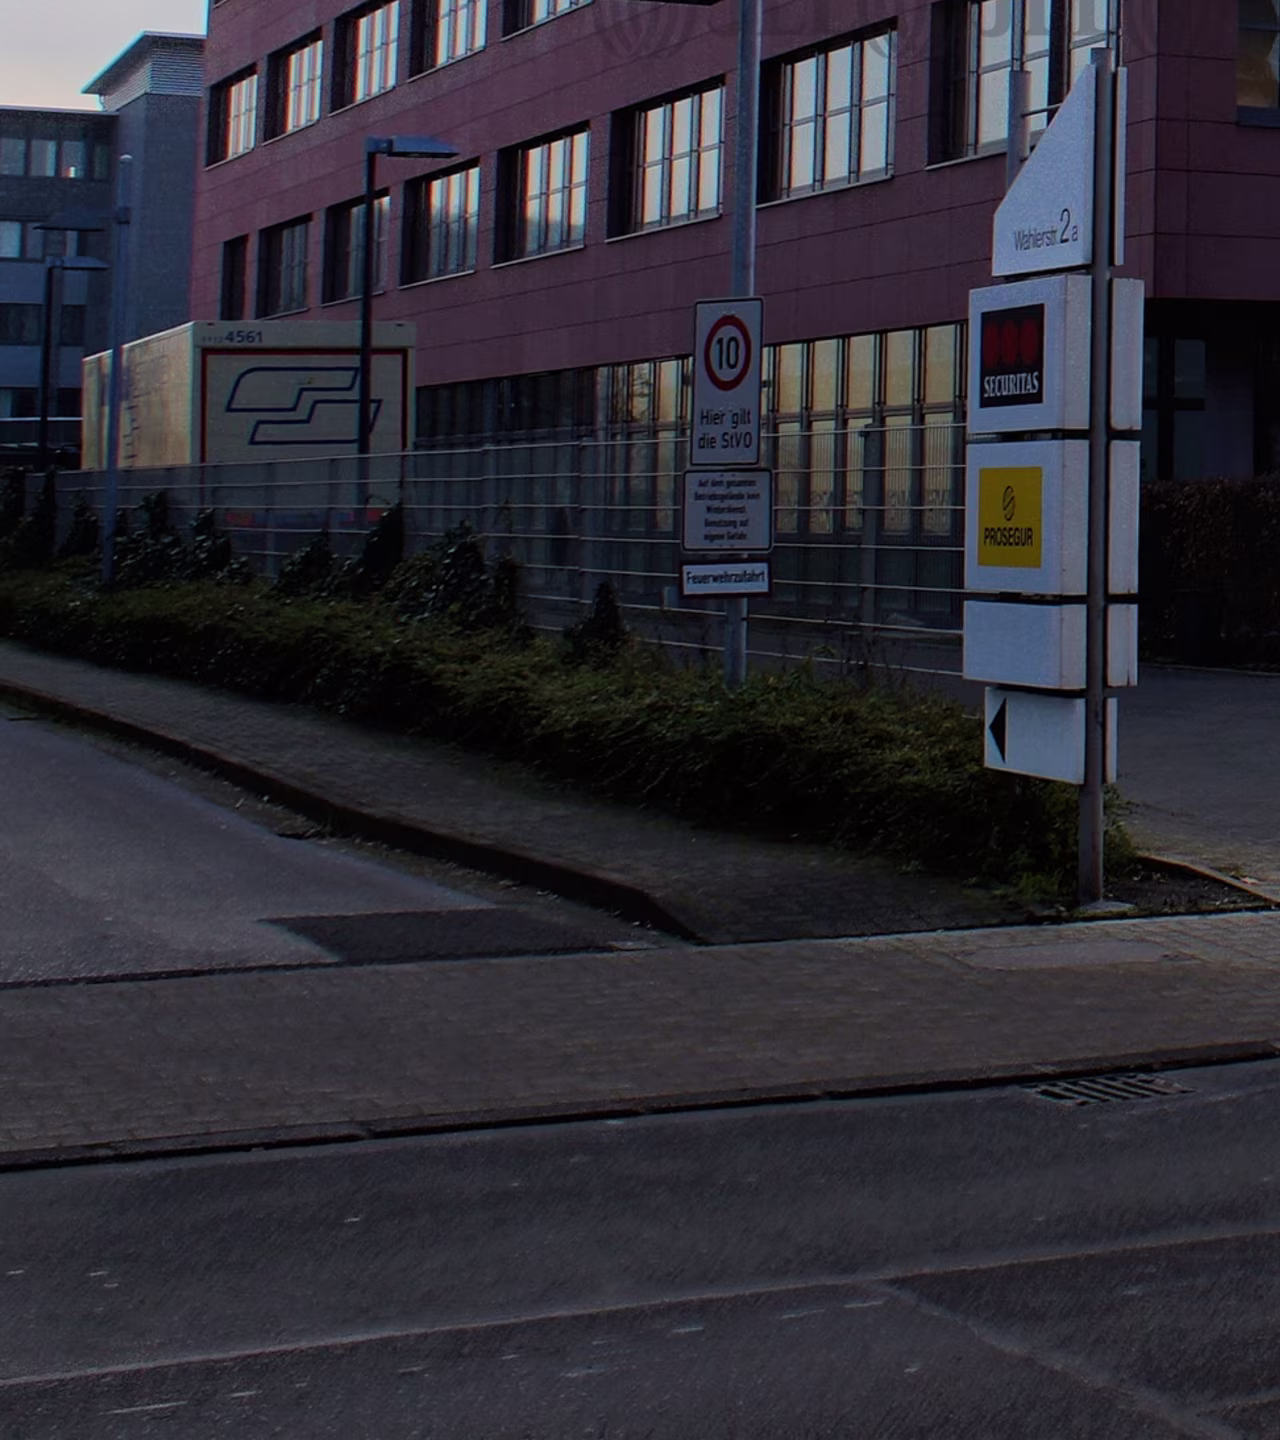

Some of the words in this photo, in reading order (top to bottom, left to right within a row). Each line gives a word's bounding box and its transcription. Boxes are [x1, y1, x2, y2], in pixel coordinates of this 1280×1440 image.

[1060, 208, 1071, 244] 2
[1071, 224, 1079, 242] a
[224, 330, 263, 343] 4561
[716, 336, 739, 370] 10
[984, 371, 1039, 397] SECURITAS
[700, 409, 726, 426] Hier
[731, 410, 752, 429] gilt
[698, 433, 717, 450] die
[721, 431, 753, 449] StVO
[984, 527, 1034, 546] PROSEGUR
[686, 569, 766, 585] Feuerwehrzufahrt
